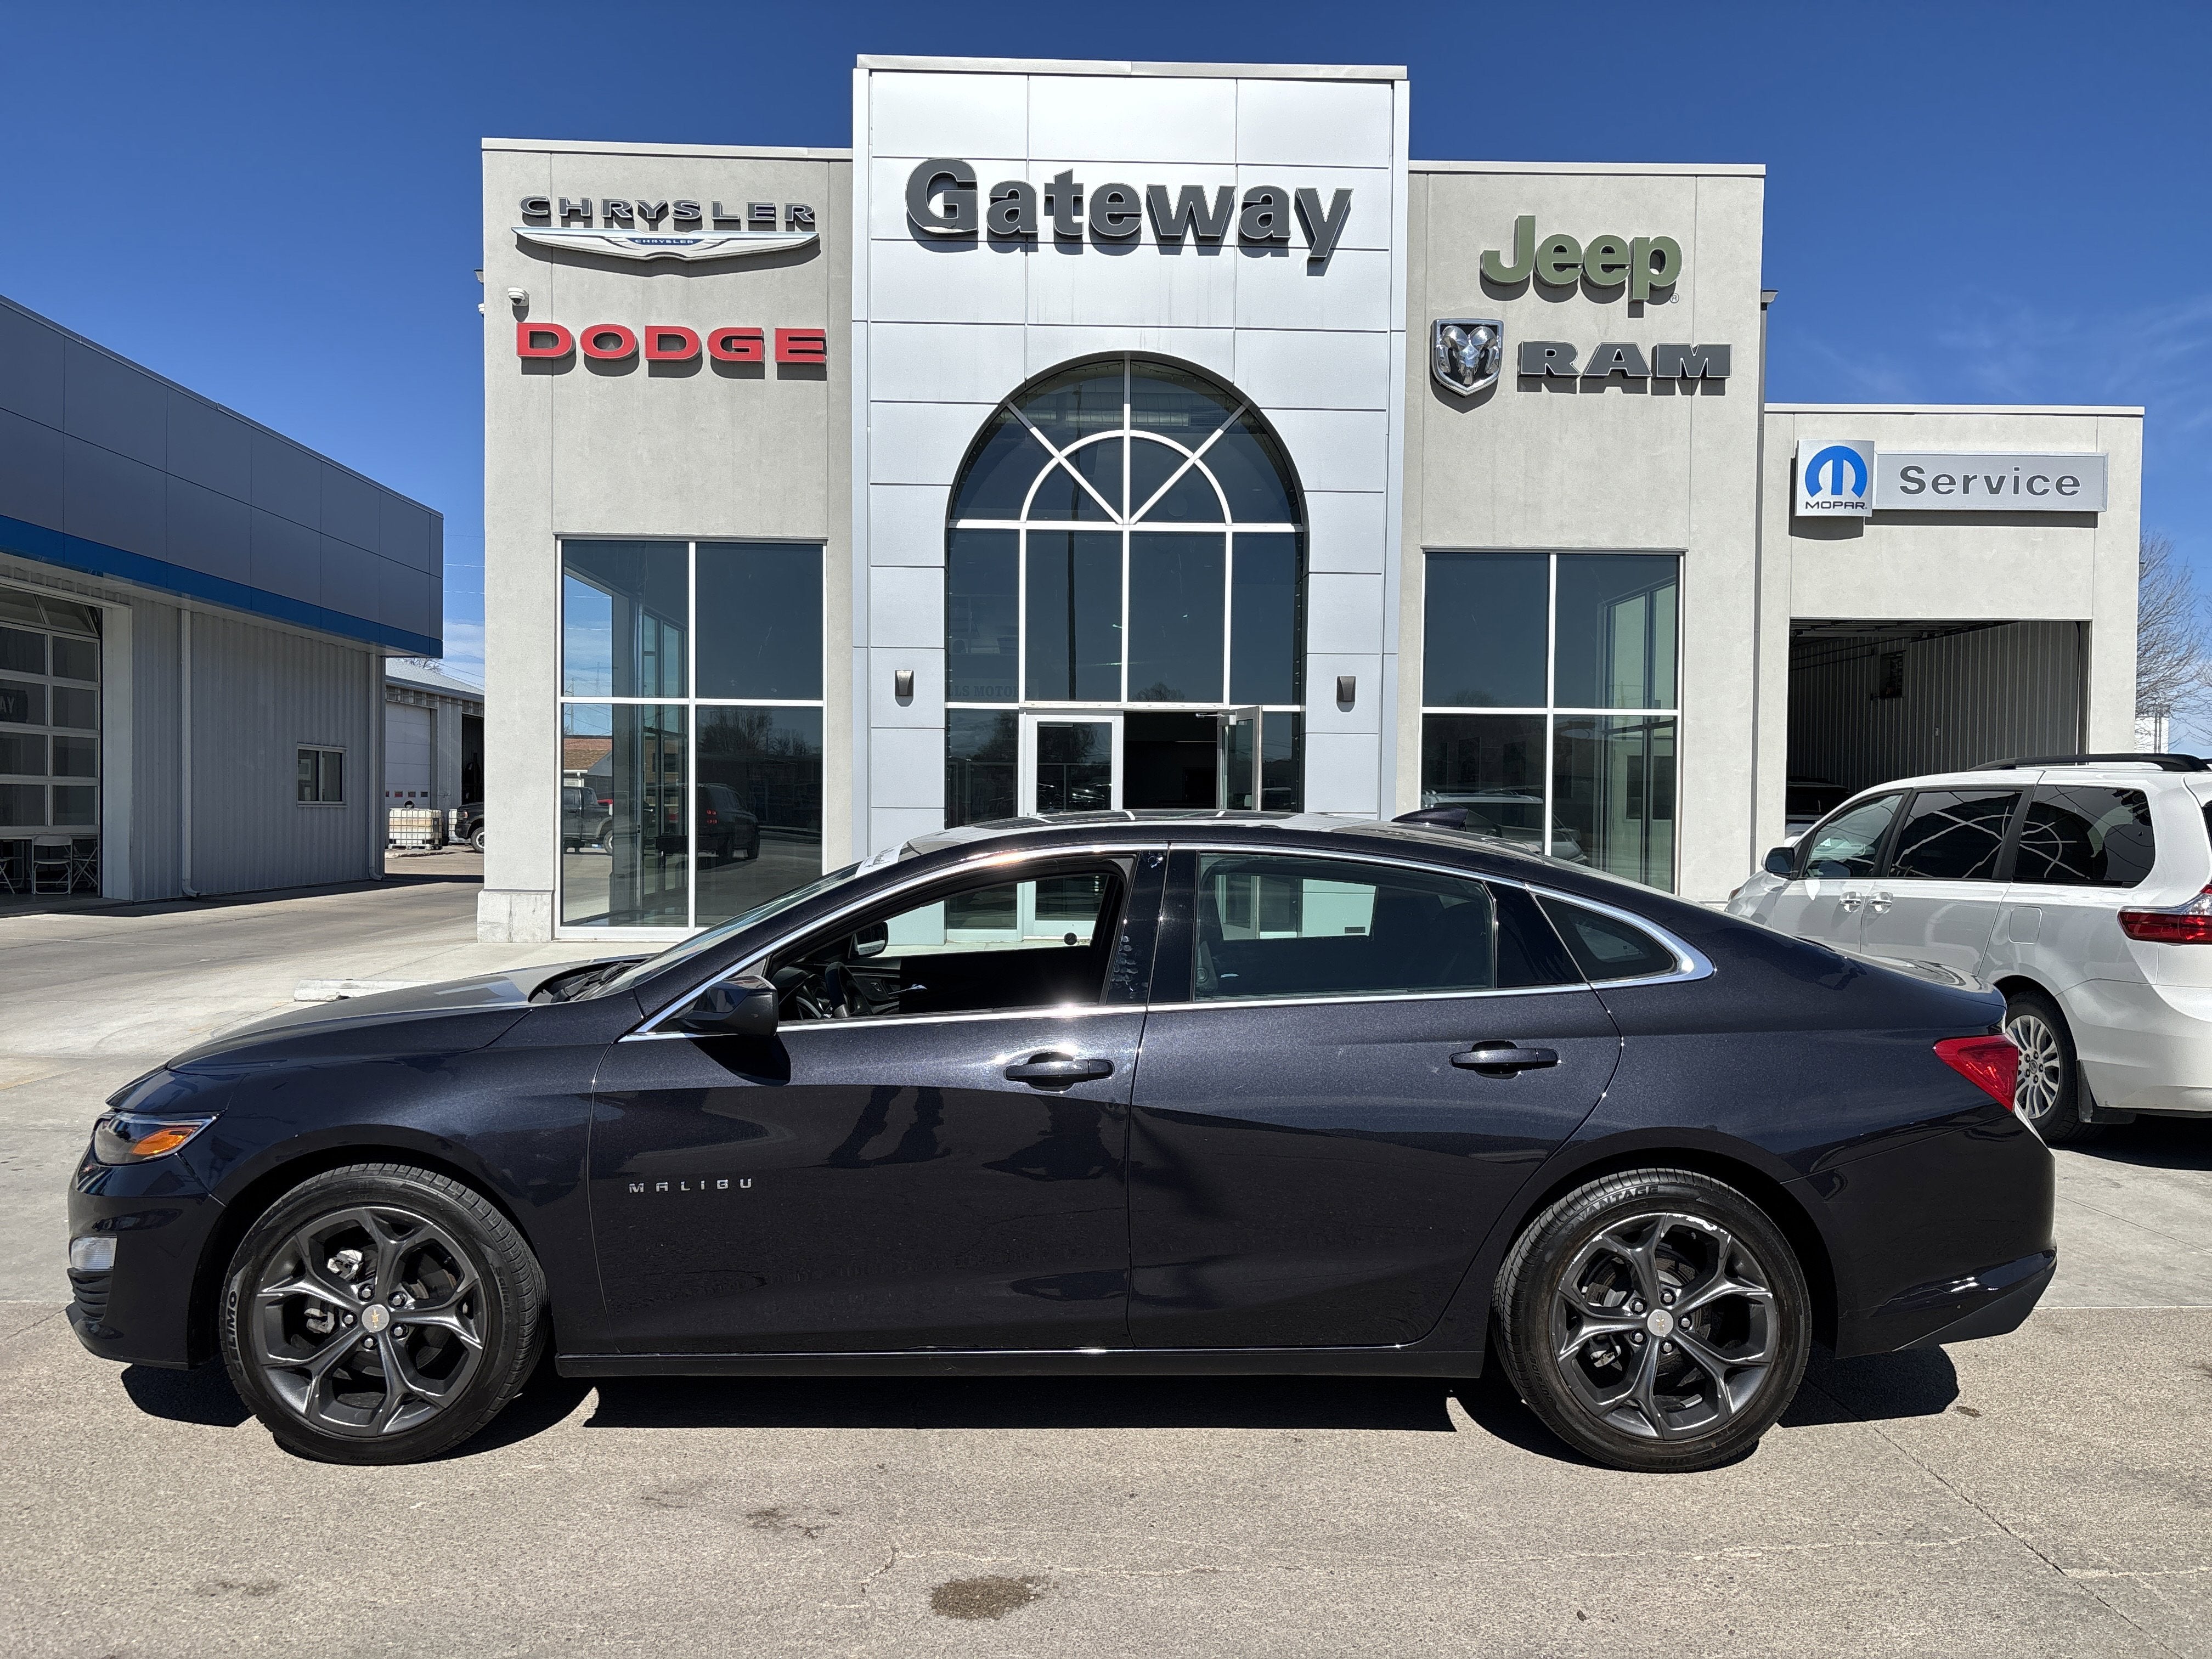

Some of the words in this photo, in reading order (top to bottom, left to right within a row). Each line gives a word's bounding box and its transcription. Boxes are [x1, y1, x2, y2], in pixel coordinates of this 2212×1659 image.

[518, 195, 815, 222] CHRYSLER
[905, 158, 1354, 262] Gateway
[1480, 215, 1683, 301] Jeep
[516, 322, 826, 365] DODGE
[1517, 340, 1733, 379] RAM
[1899, 465, 2081, 495] Service
[1805, 501, 1865, 510] MOPAR
[629, 1178, 752, 1193] MALIBU
[1578, 1186, 1659, 1222] VANTAGE
[227, 1290, 243, 1376] CELIMO
